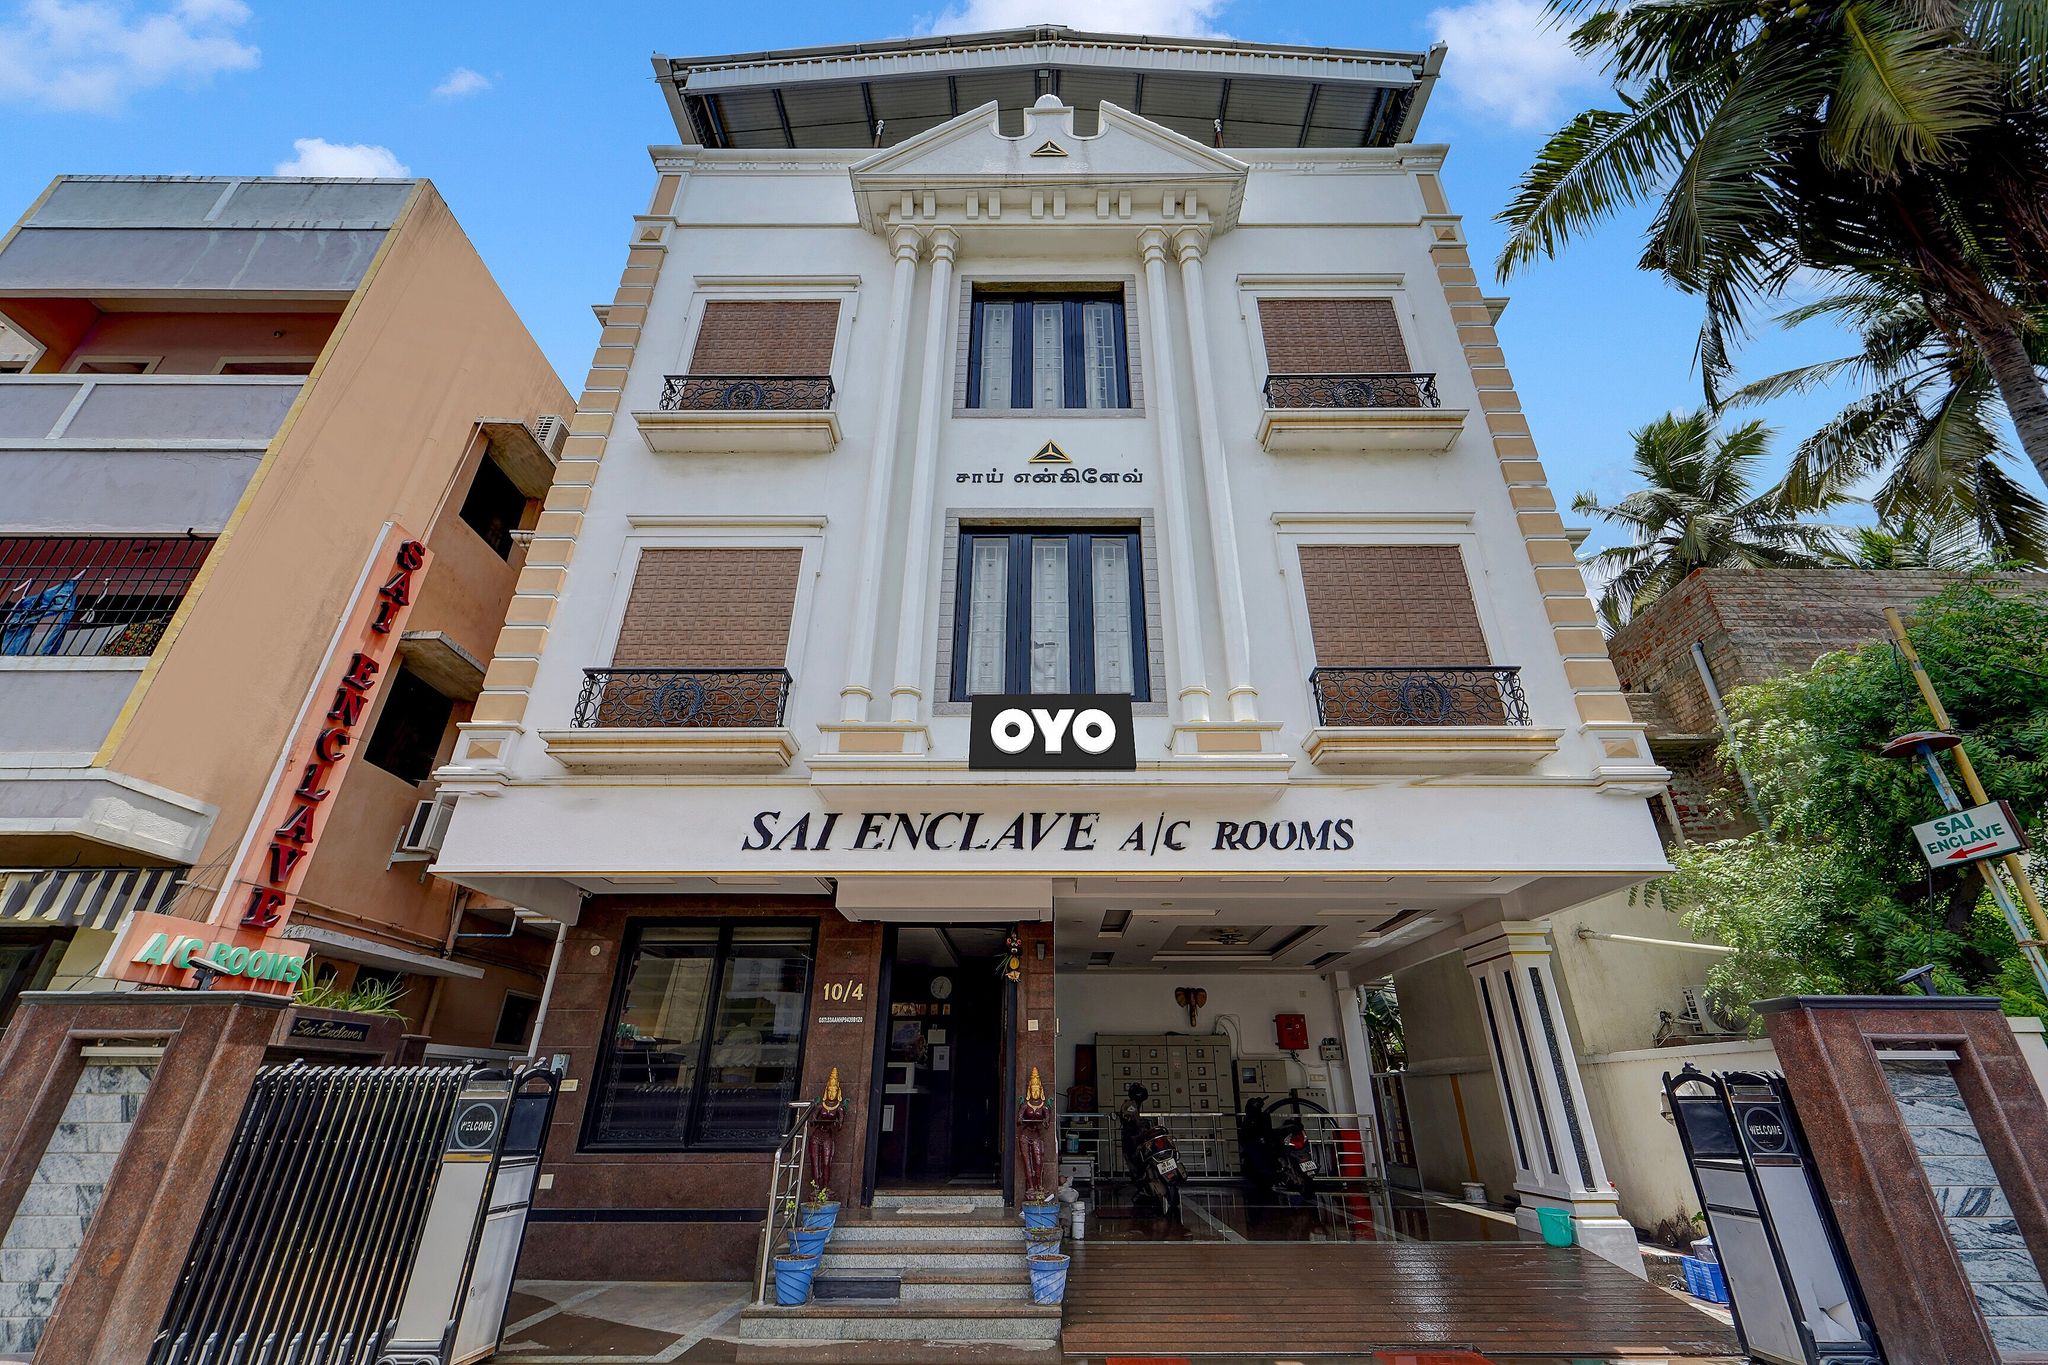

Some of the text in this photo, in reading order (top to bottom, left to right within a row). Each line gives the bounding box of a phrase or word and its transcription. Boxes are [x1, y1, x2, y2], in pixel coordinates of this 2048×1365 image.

[956, 467, 1144, 484] சாய் என்கிளேவ்
[240, 539, 426, 929] SAI ENCLAVE
[990, 708, 1117, 755] OYO
[741, 811, 1355, 856] SAI ENCLAVE A/C ROOMS
[1926, 823, 2006, 855] ENCLAVE
[1933, 813, 1975, 837] SAI
[131, 932, 303, 983] A/C ROOMS
[823, 979, 864, 1003] 10/4
[1748, 1124, 1783, 1135] WELCOME
